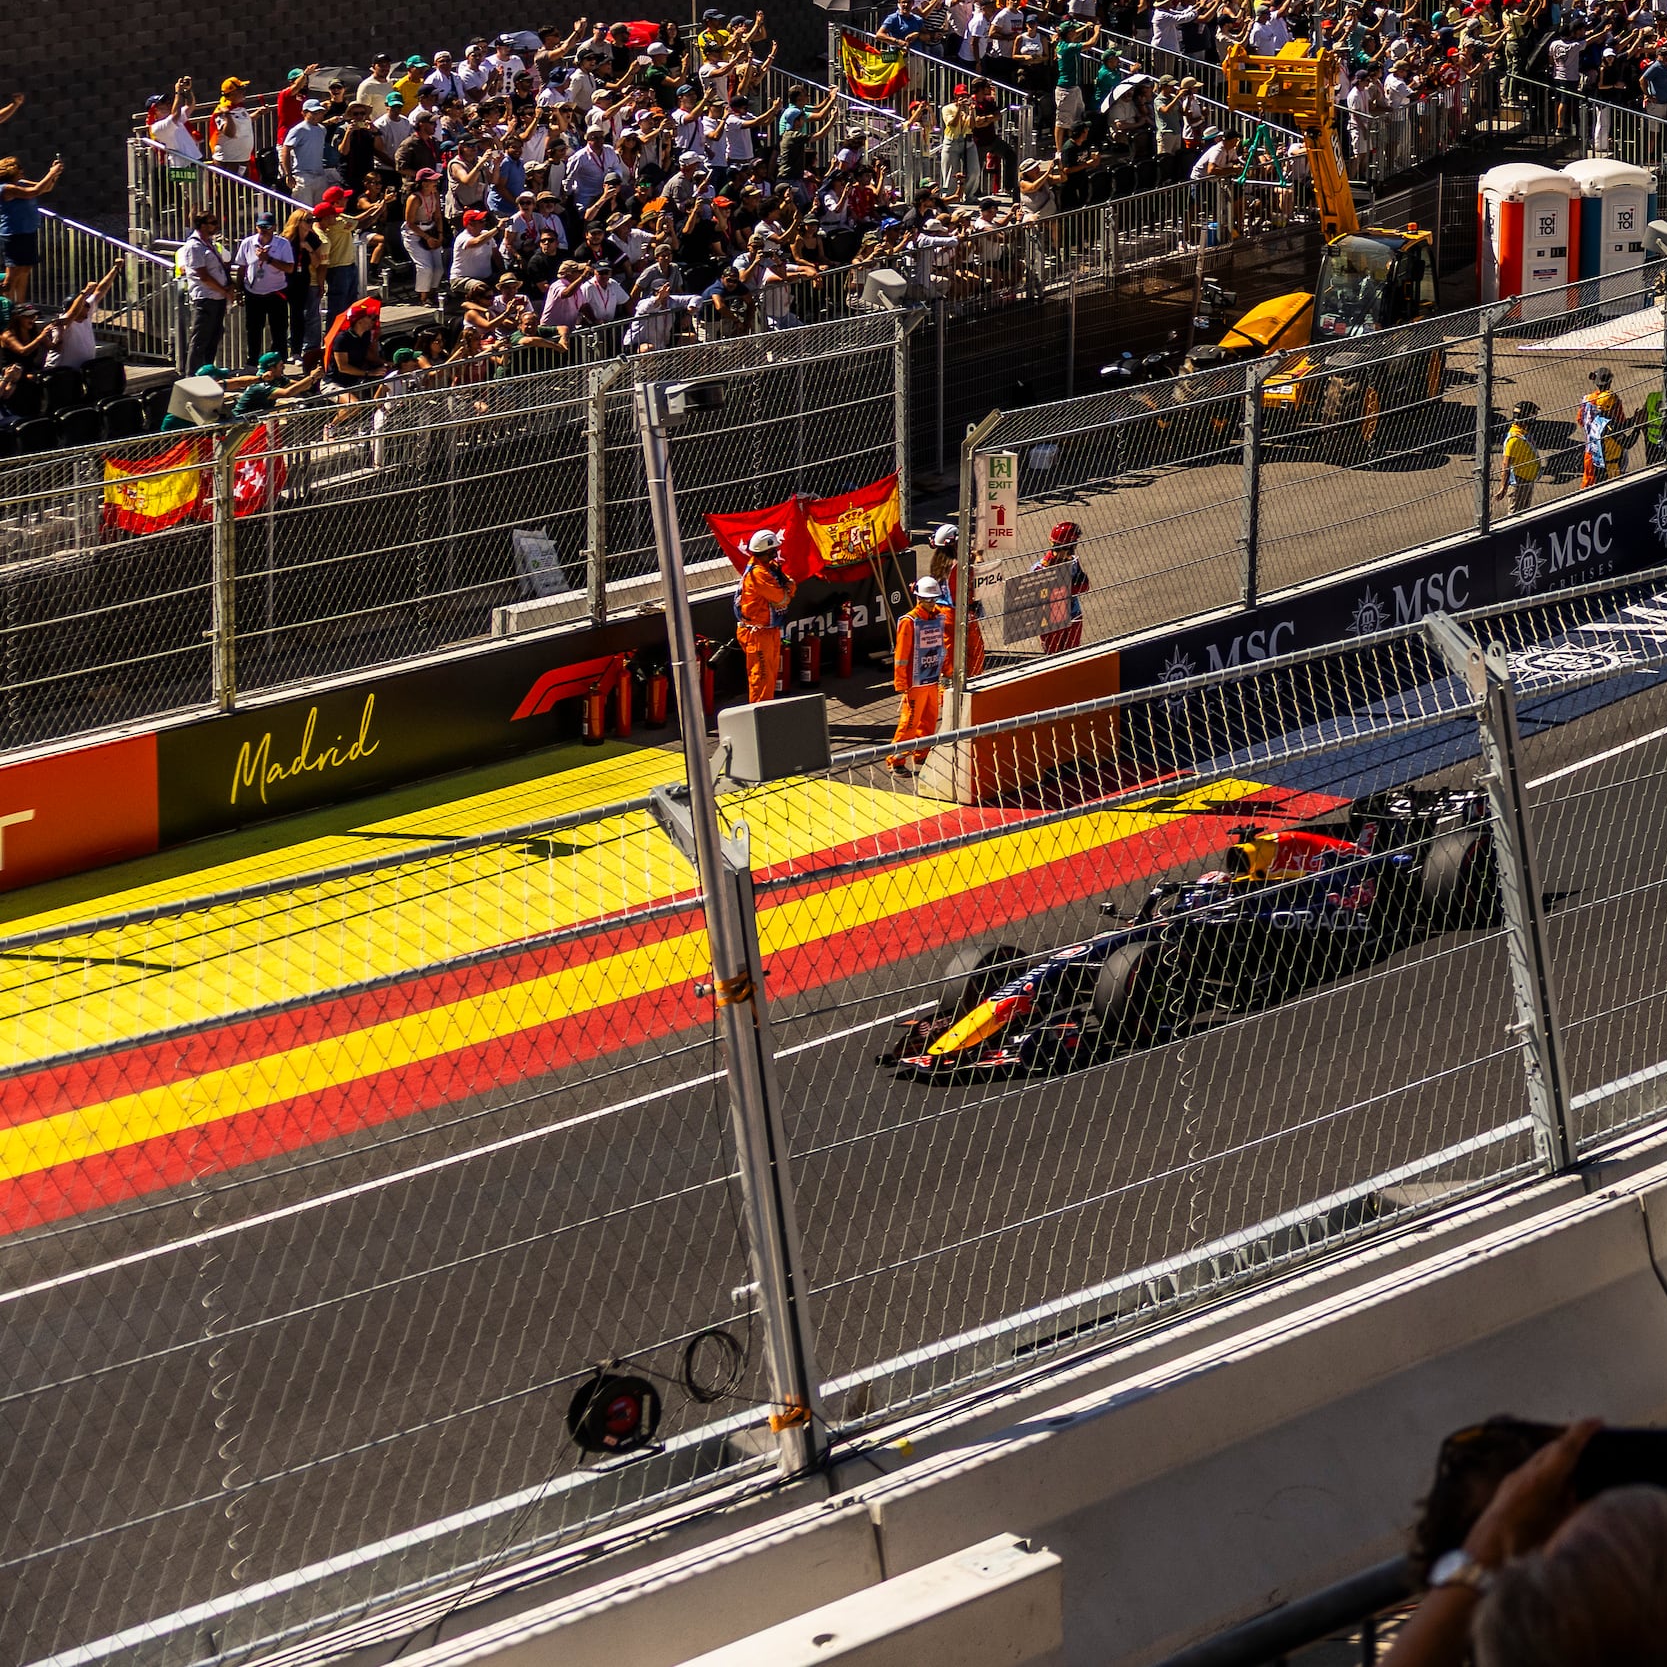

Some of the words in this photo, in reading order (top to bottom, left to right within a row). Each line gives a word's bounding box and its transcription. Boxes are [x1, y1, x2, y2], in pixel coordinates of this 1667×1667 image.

[1329, 135, 1345, 176] JCB
[170, 171, 196, 180] SALIDA
[1539, 225, 1556, 236] TOI
[1617, 220, 1634, 230] TOI
[988, 481, 1013, 490] EXIT
[988, 528, 1013, 537] FIRE
[1548, 512, 1613, 574] MSC
[1393, 564, 1470, 626] MSC
[785, 605, 869, 643] rmua
[231, 693, 380, 805] Madrid
[1272, 910, 1373, 931] ORACLE
